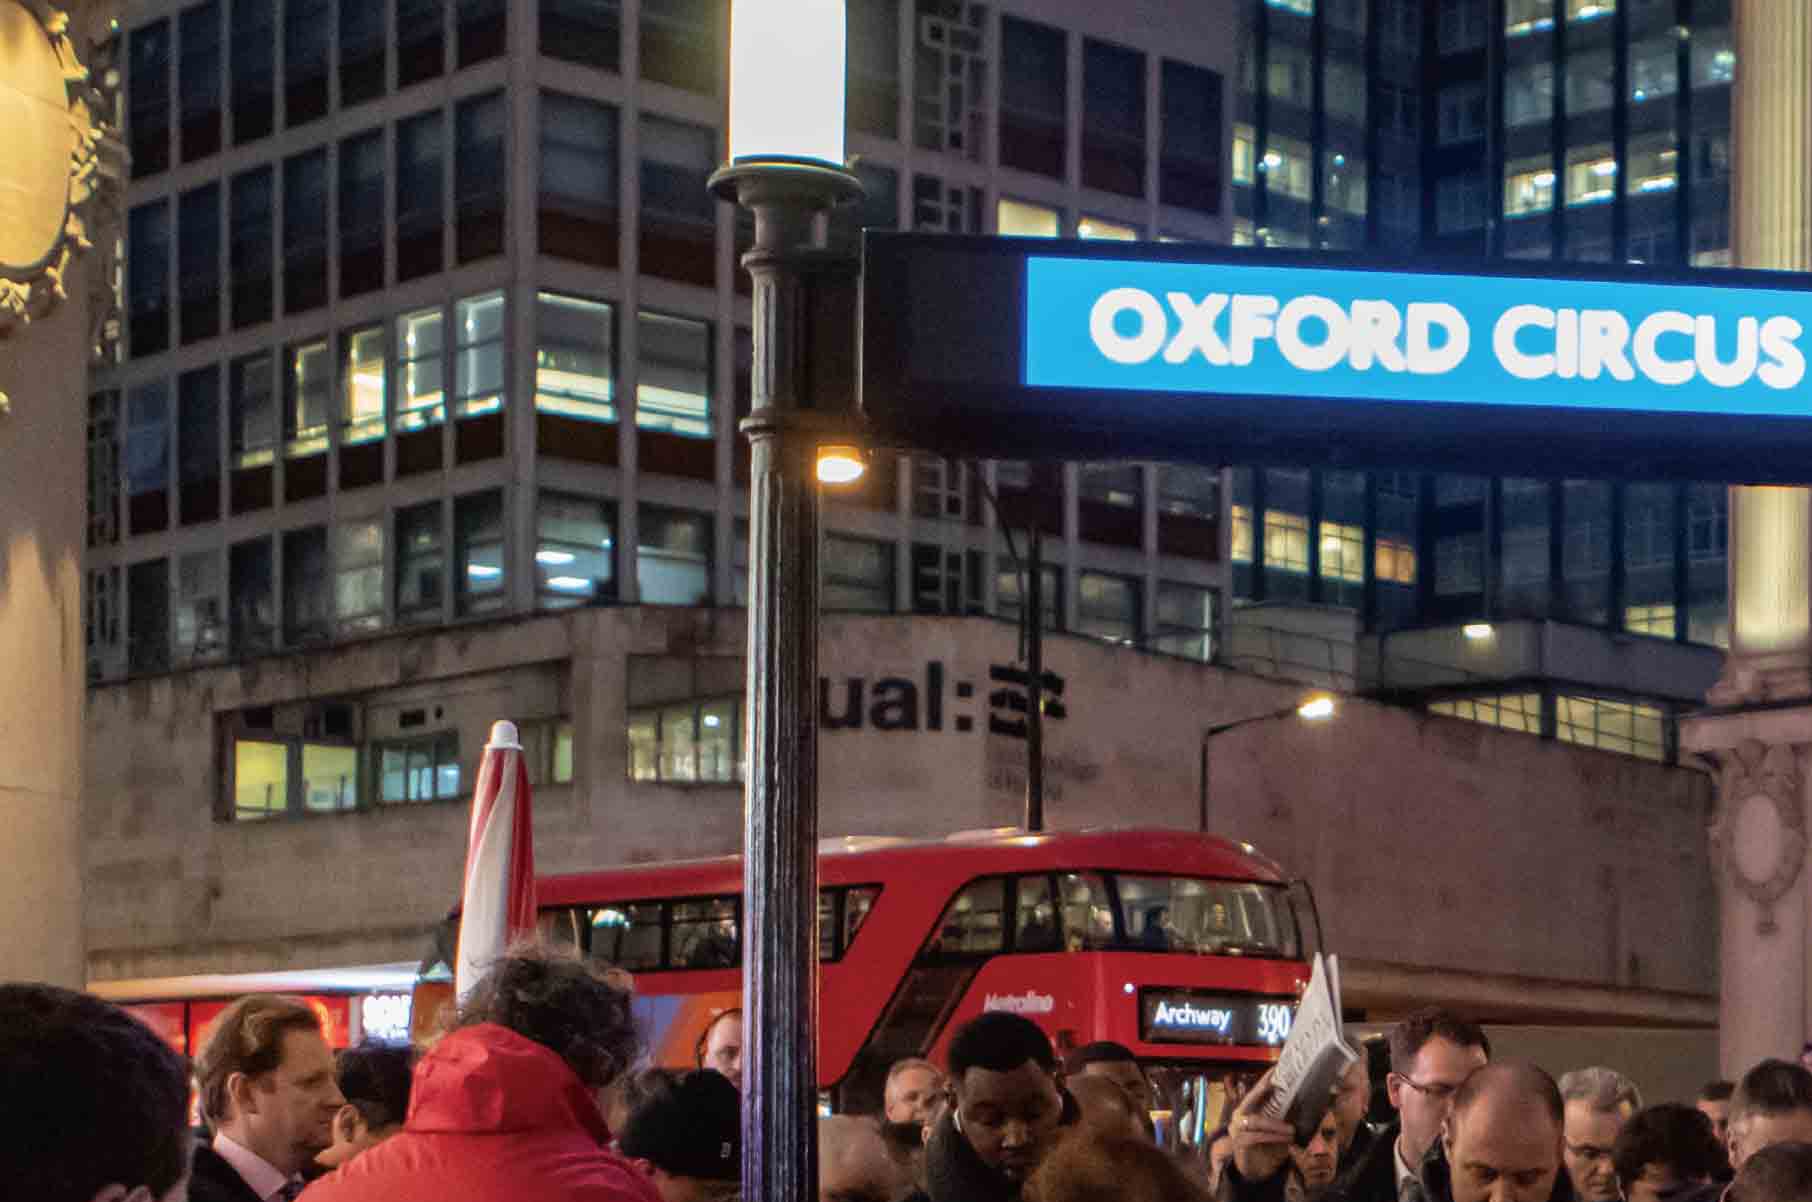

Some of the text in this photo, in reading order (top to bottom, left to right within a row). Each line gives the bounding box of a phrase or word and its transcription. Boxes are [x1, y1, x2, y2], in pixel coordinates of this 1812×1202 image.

[1089, 287, 1470, 375] OXFORD
[1493, 304, 1806, 391] CIRCUS
[1154, 1001, 1291, 1038] Archway 390
